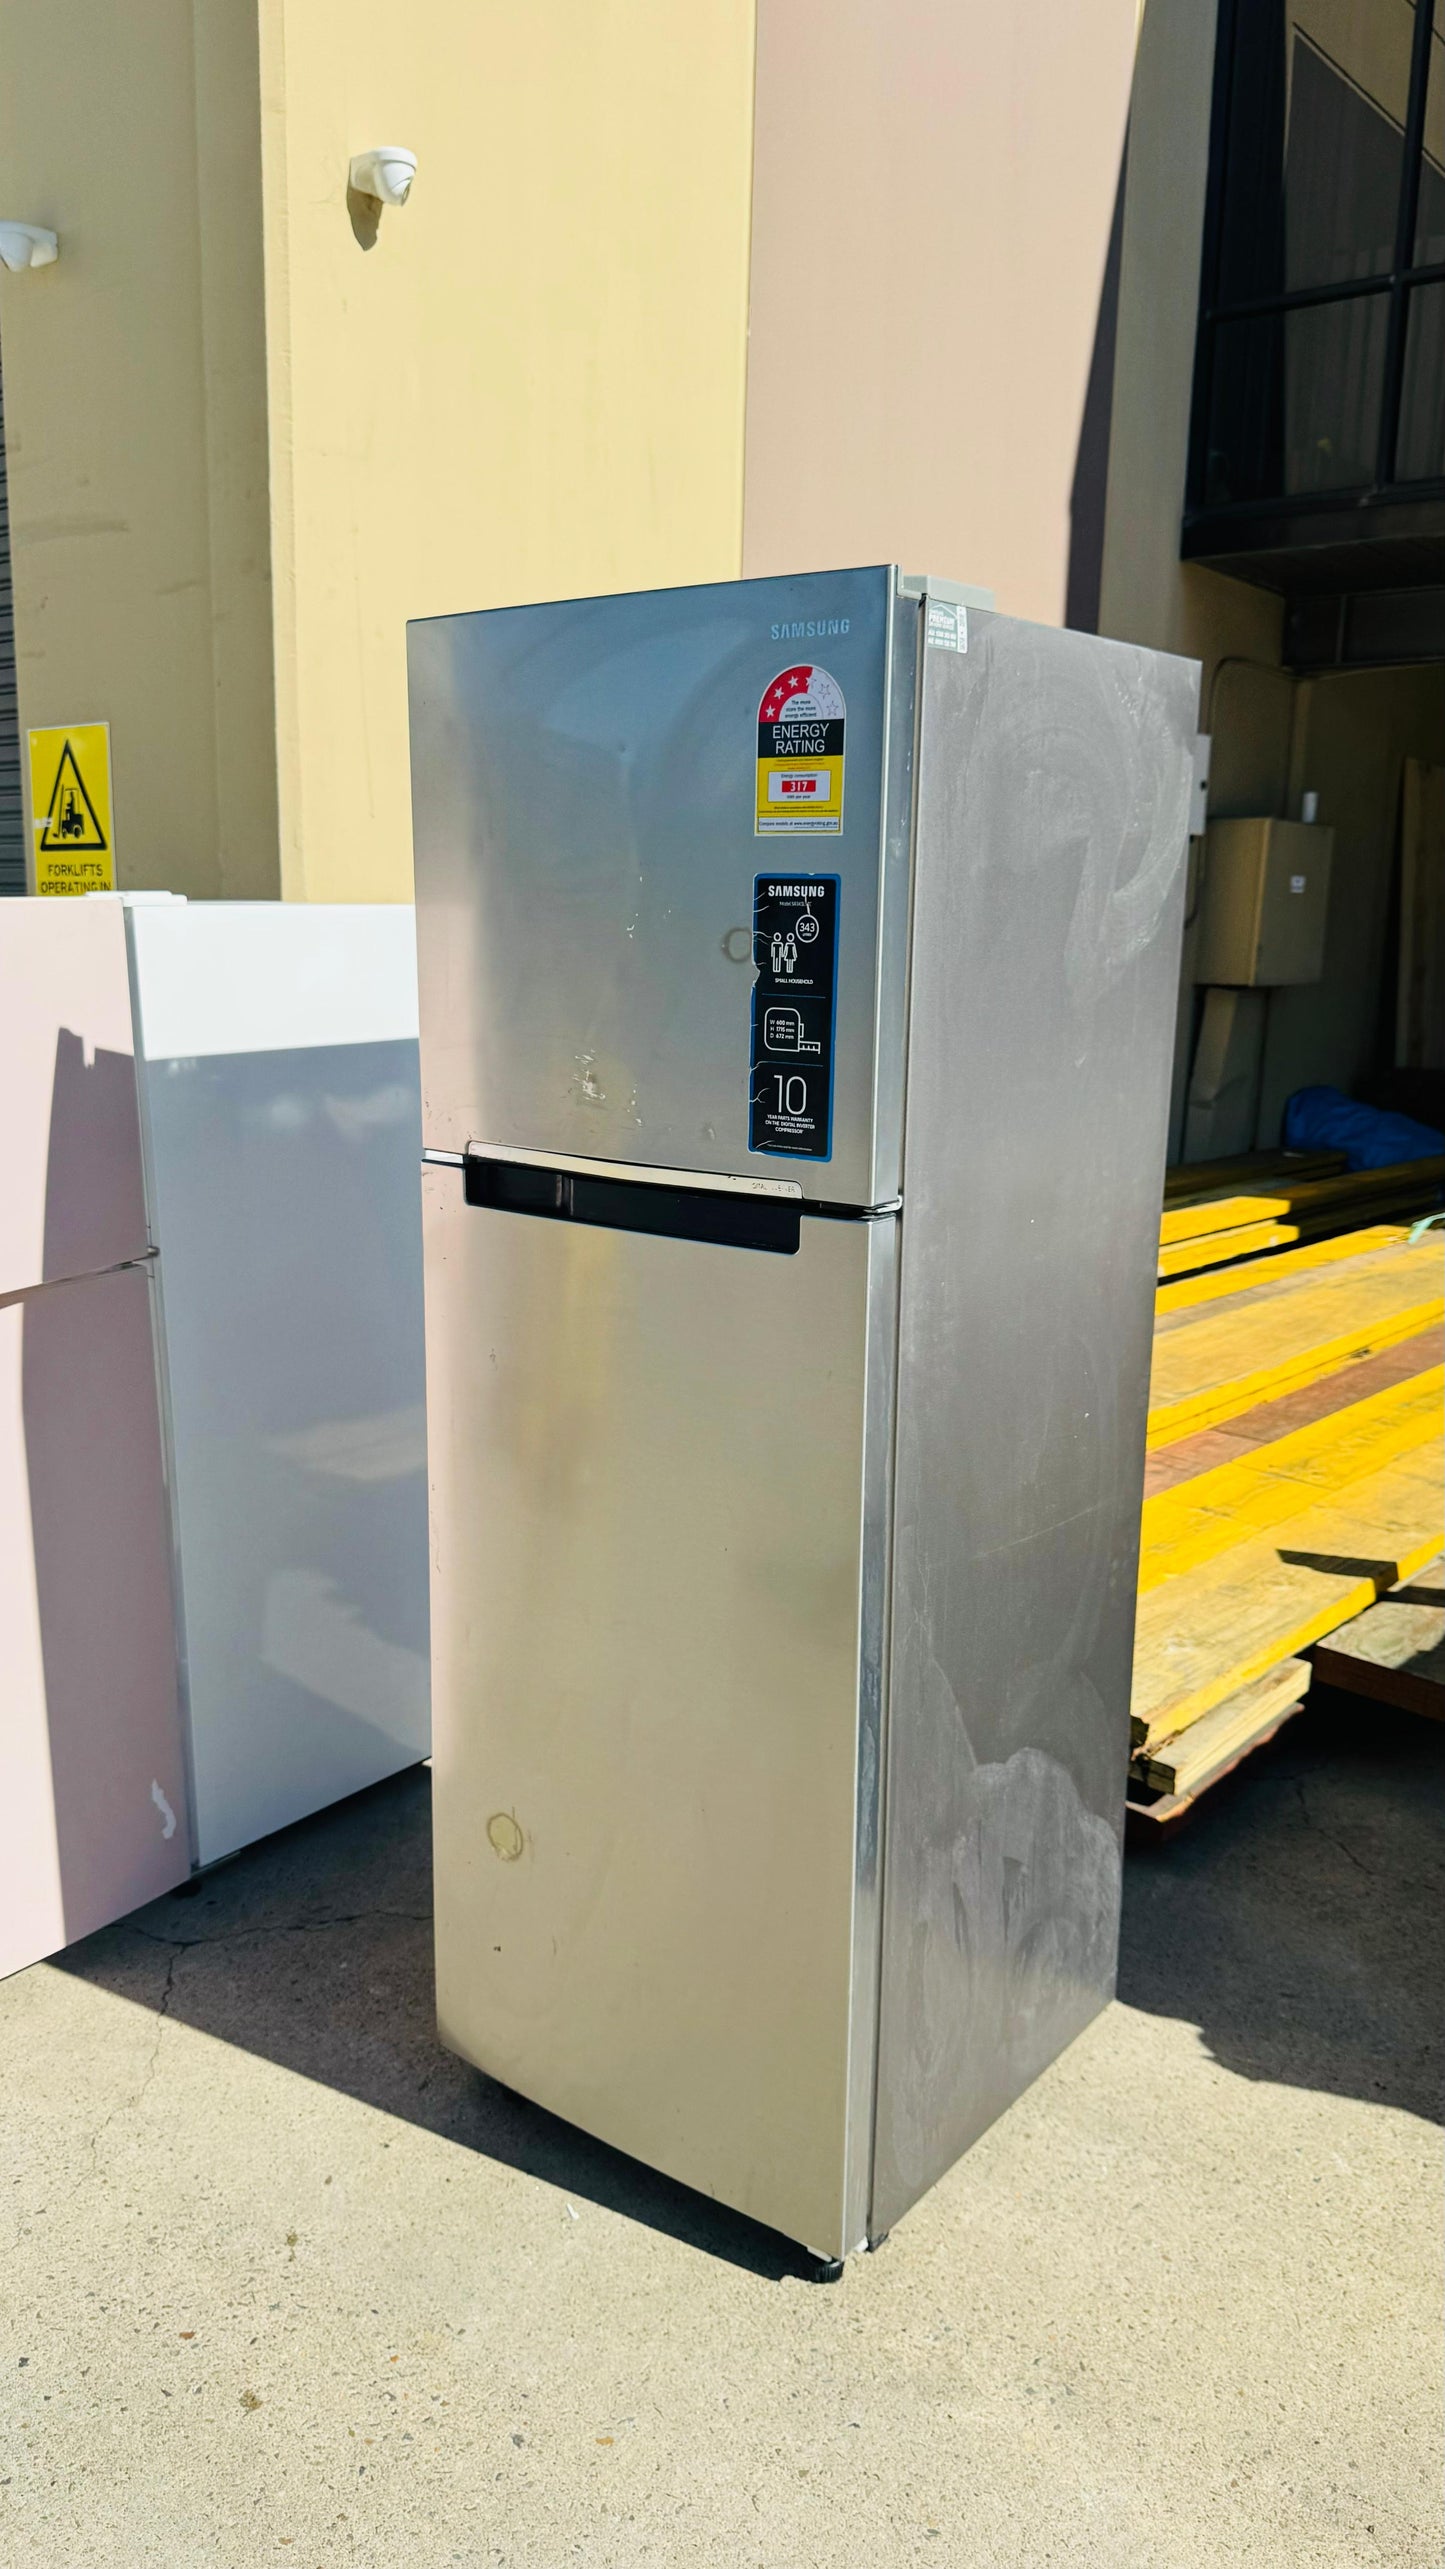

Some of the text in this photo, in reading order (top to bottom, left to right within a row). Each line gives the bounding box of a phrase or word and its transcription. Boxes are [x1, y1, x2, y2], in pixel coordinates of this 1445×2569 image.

[771, 619, 850, 640] SAMSUNG
[772, 723, 829, 739] ENERGY
[775, 739, 825, 754] RATING
[790, 781, 808, 792] 317
[47, 863, 104, 877] FORKLIFTS
[40, 881, 112, 895] OPERATING IN
[768, 885, 825, 897] SAMSUNG
[799, 922, 815, 932] 343
[774, 1074, 807, 1115] 10
